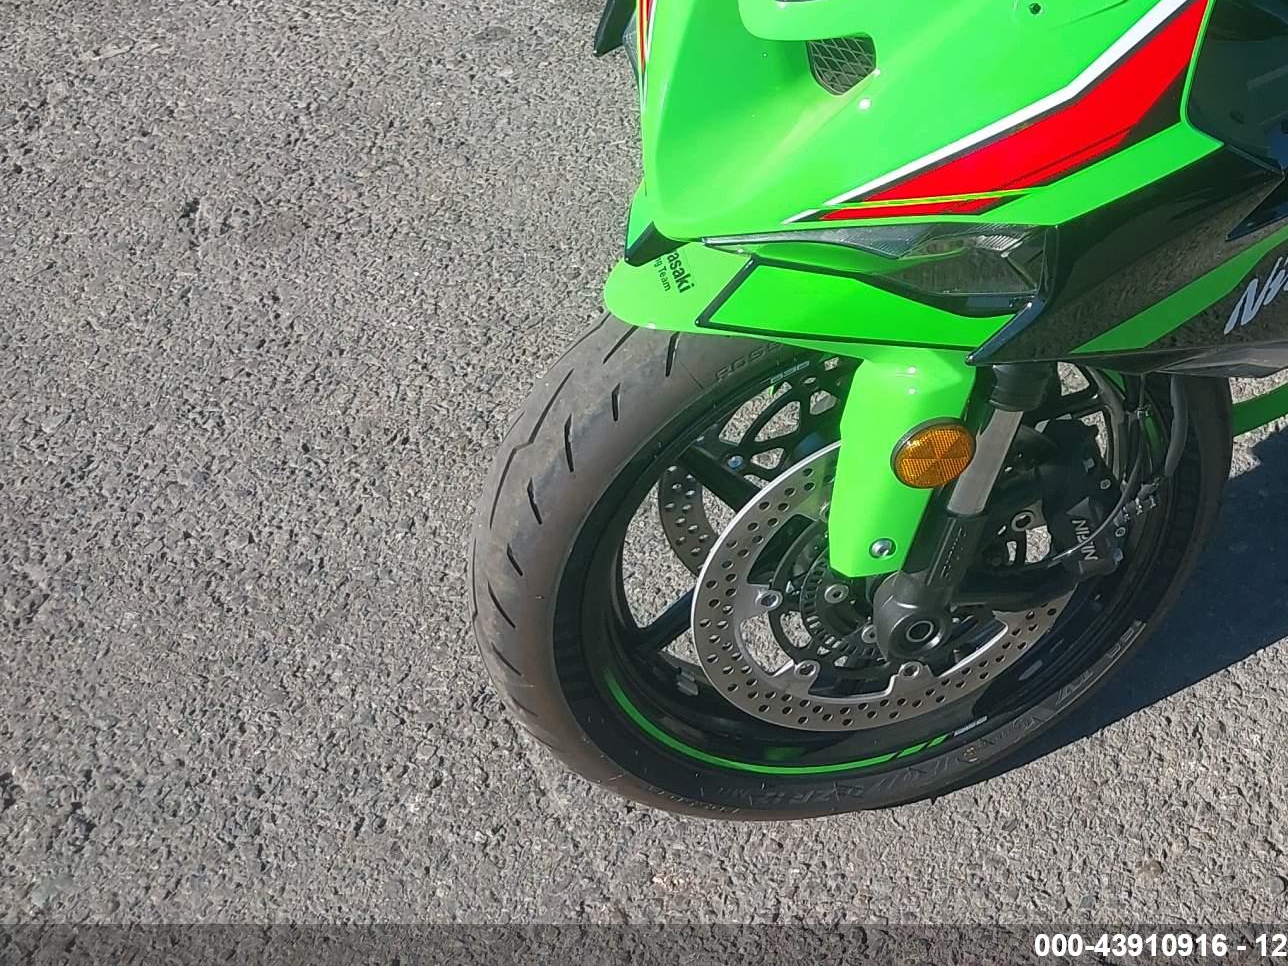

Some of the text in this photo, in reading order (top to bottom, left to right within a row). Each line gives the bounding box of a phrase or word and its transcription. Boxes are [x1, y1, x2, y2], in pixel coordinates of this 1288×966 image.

[658, 265, 671, 292] Team
[667, 252, 694, 293] asaki
[1071, 519, 1099, 561] NISIN
